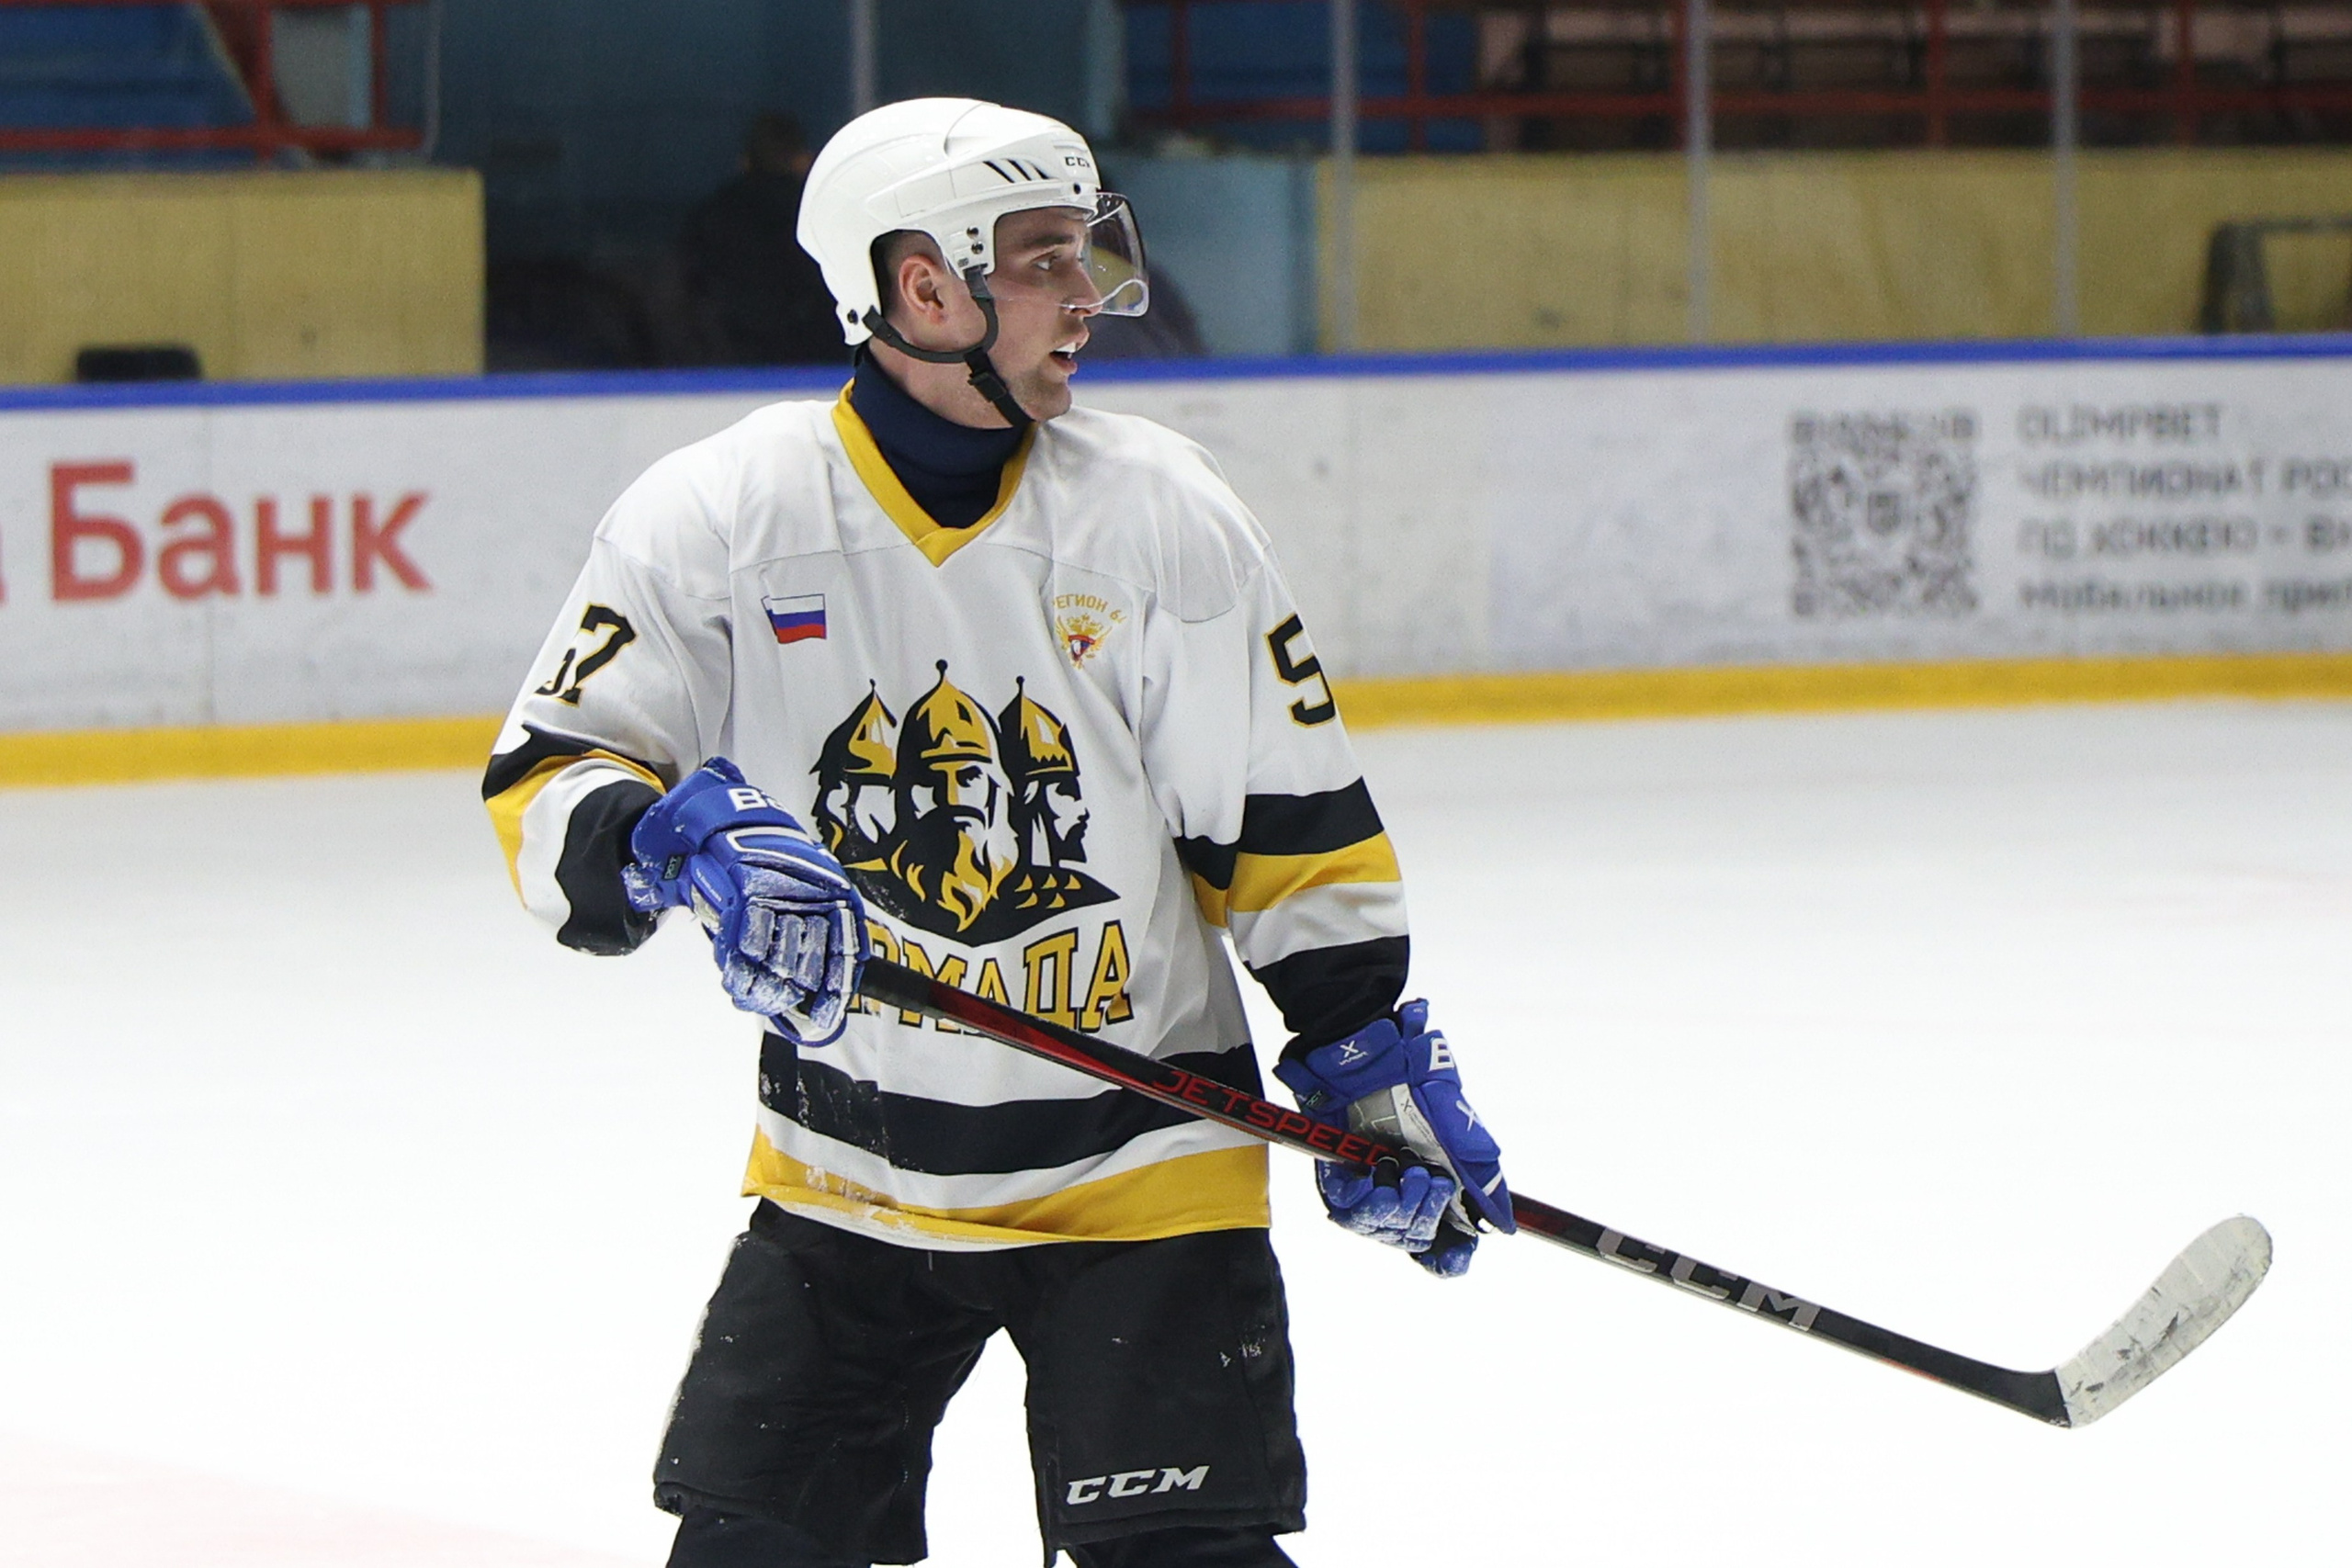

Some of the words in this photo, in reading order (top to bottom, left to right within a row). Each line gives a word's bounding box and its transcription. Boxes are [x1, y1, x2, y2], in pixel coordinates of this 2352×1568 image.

[50, 459, 434, 604] Банк
[1053, 593, 1108, 613] ЕГИОН
[1263, 611, 1337, 728] 5
[1596, 1228, 1821, 1331] CCM
[1066, 1465, 1210, 1506] CCM
